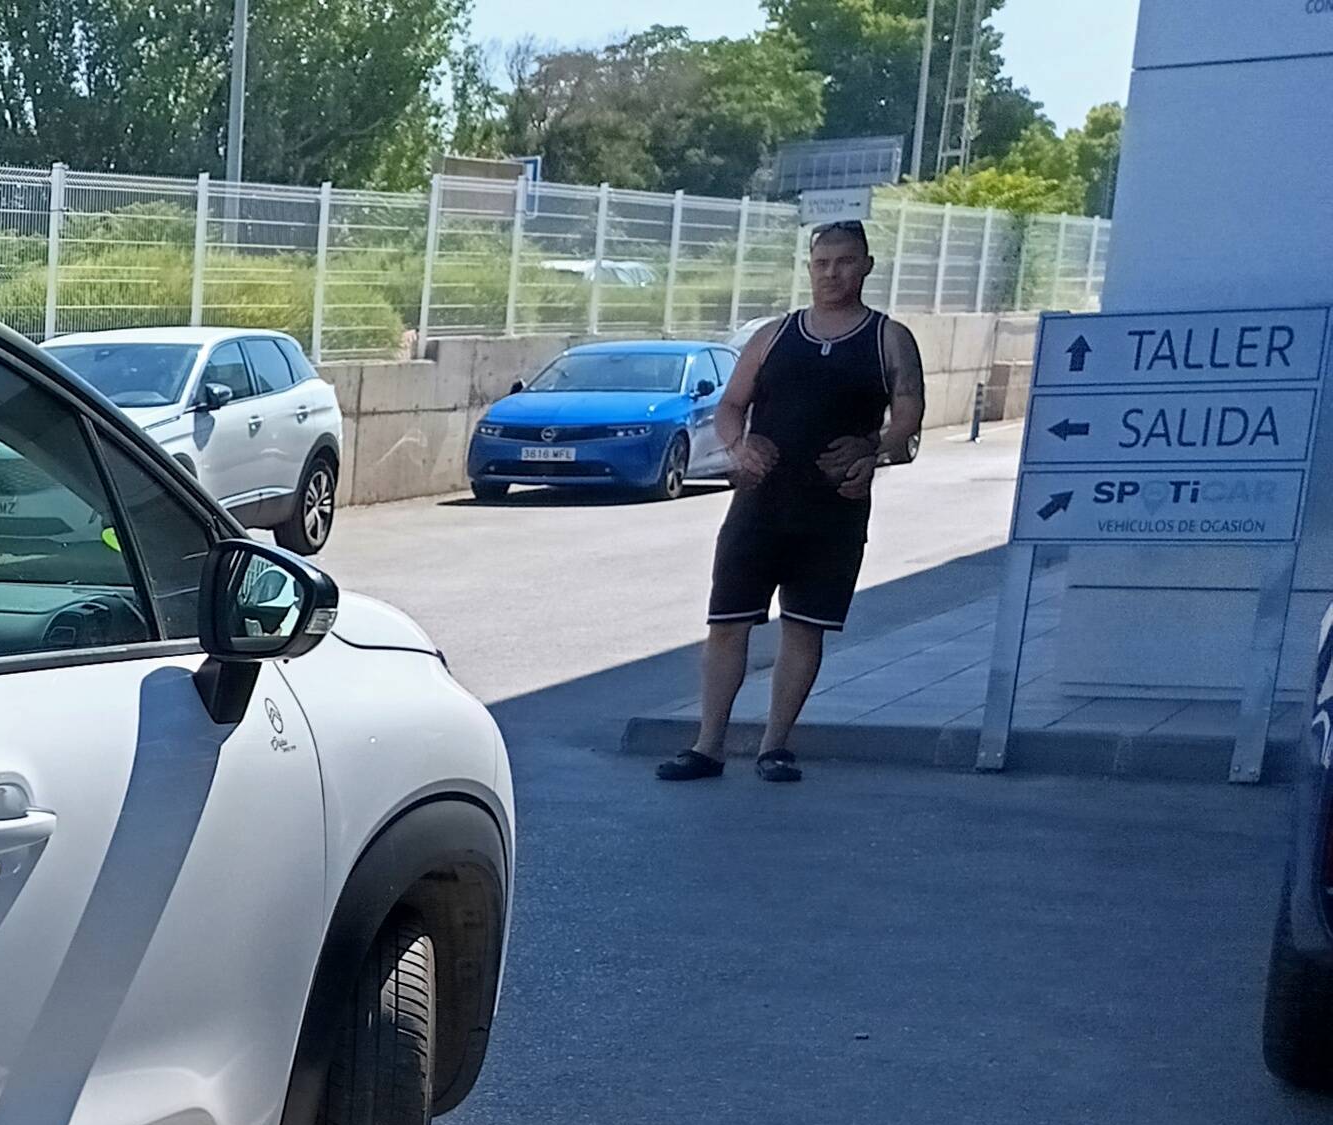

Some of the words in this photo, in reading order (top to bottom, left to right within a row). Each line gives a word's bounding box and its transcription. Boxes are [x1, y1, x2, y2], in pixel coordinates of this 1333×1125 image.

[1128, 325, 1295, 371] TALLER
[1118, 406, 1279, 448] SALIDA
[1178, 519, 1195, 533] DE
[1200, 518, 1265, 533] OCASIÓN
